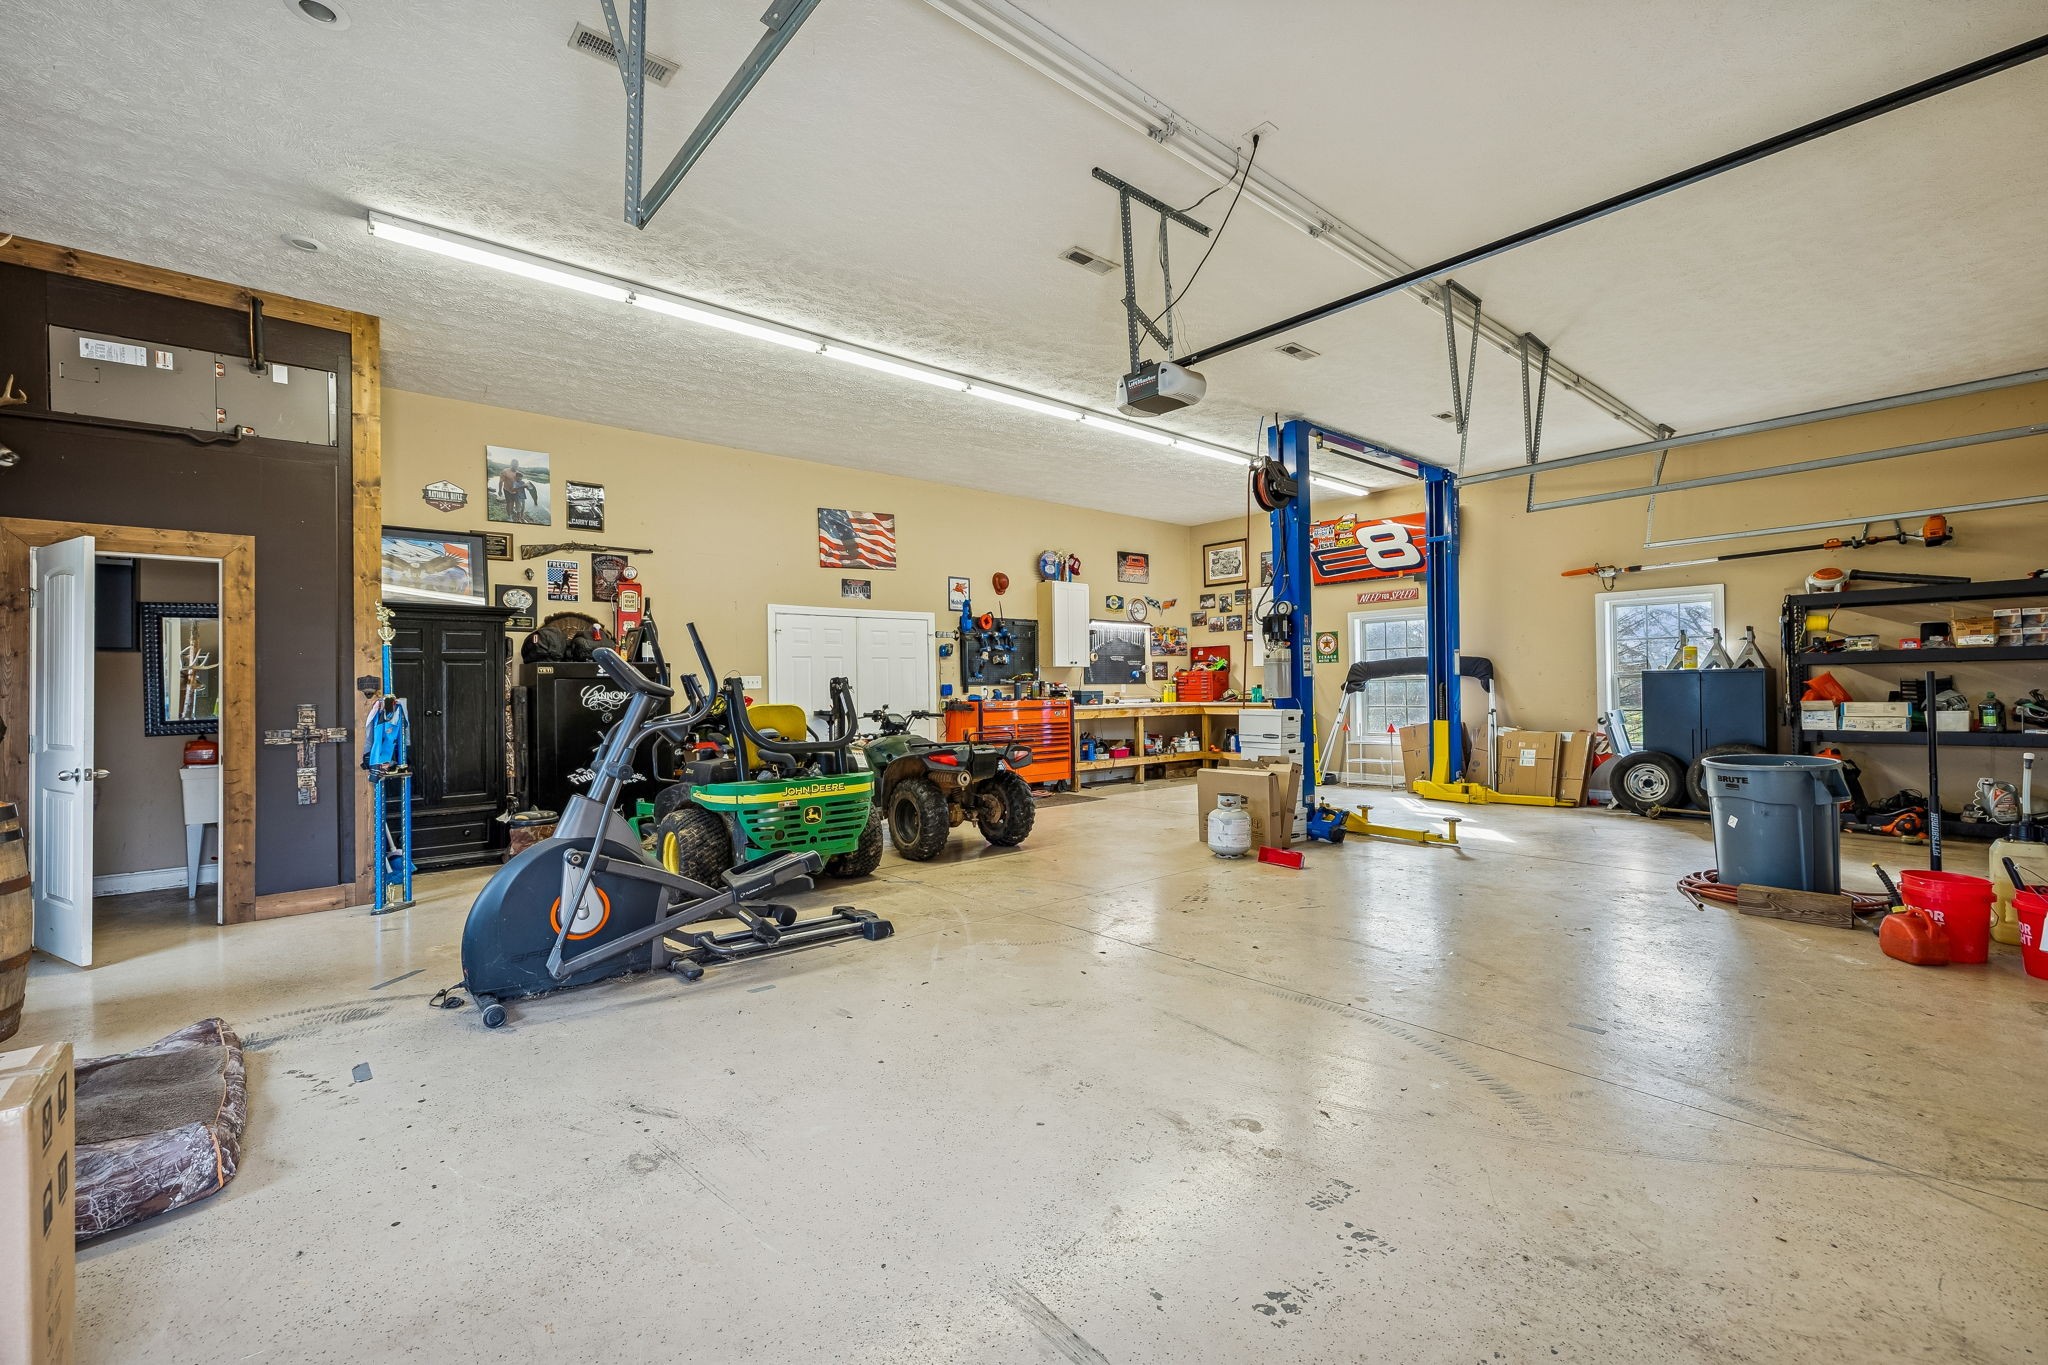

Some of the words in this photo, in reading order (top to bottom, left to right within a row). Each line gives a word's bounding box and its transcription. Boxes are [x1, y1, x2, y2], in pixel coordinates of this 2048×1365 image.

[571, 518, 588, 526] CARRY
[1355, 522, 1425, 572] 8
[548, 560, 577, 569] FREEDOM
[1360, 592, 1381, 603] NEED
[1390, 589, 1416, 601] SPEED
[1717, 775, 1749, 785] BRUTE
[781, 786, 810, 797] JOHN
[811, 782, 845, 793] DEERE
[1931, 812, 1941, 857] PITTSBURGH
